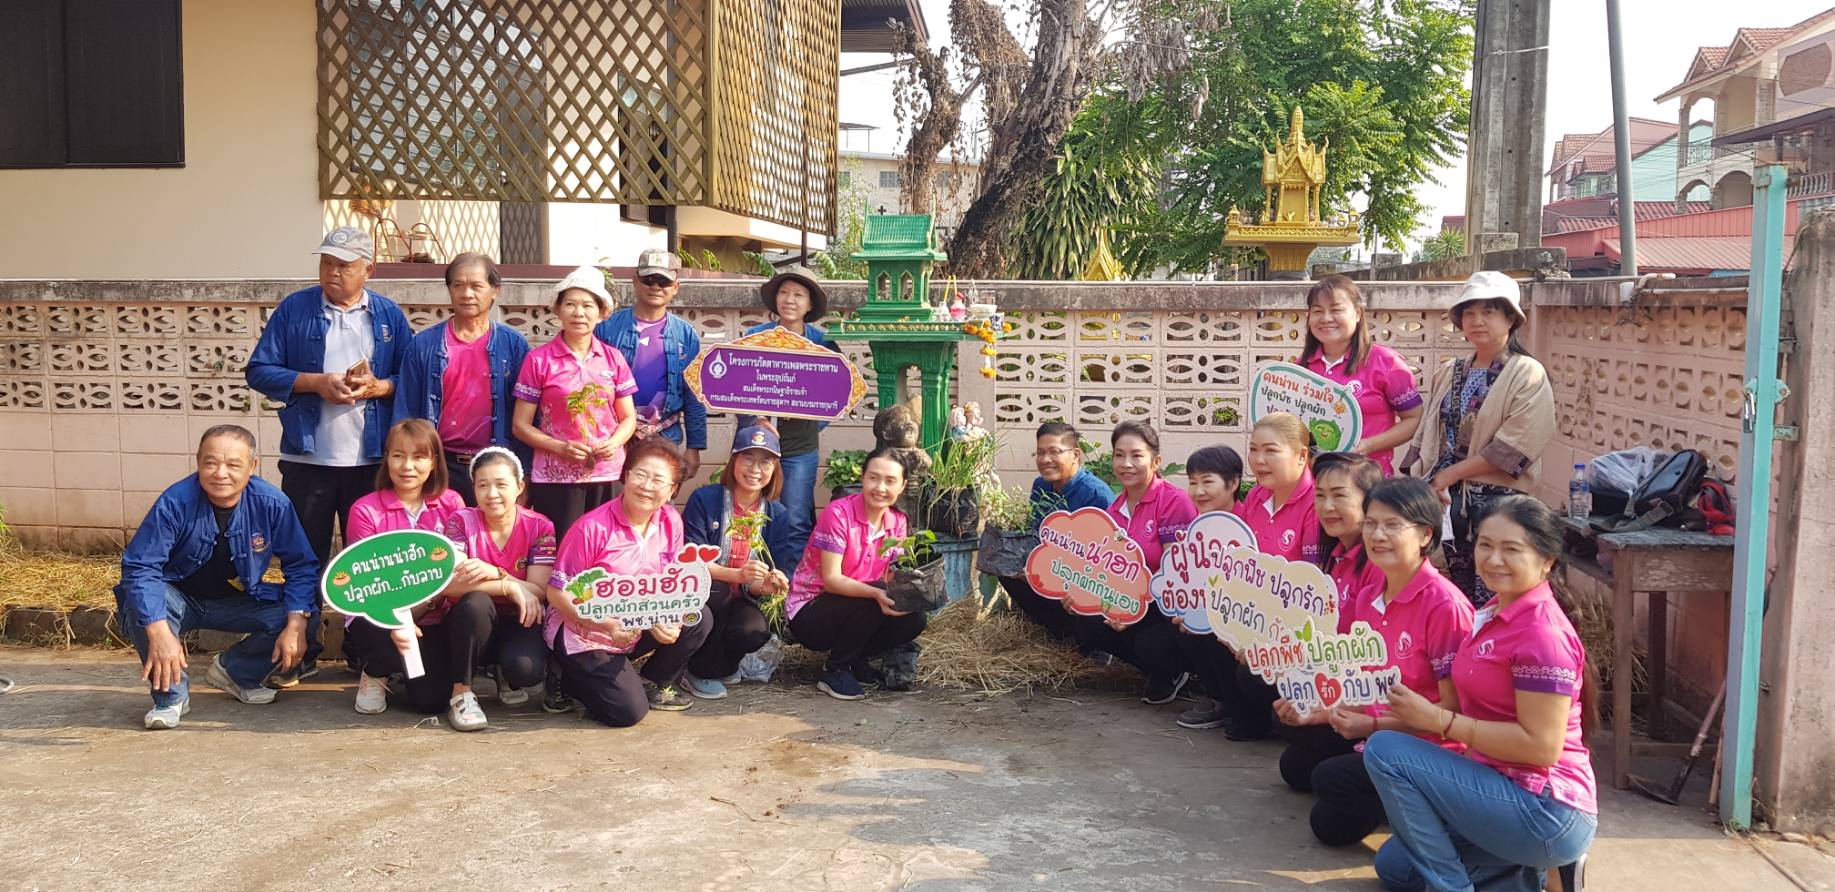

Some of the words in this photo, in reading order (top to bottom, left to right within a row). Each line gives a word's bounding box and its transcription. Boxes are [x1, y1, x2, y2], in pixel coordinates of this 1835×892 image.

[1261, 386, 1292, 405] ปลูกพืช
[1295, 397, 1326, 417] ปลูกผัก
[1263, 372, 1299, 392] คนน่าน
[1303, 382, 1334, 404] ร่วมใจ
[352, 543, 426, 575] คนน่านน่าฮัก
[595, 567, 699, 598] ฮอมฮัก
[1051, 559, 1139, 614] ปลูกผักกินเอง
[1211, 548, 1266, 588] ปลูกพืช
[1270, 573, 1324, 616] ปลูกรัก
[578, 594, 701, 620] ปลูกผักสวนครัว
[622, 612, 680, 627] พช.น่าน
[1211, 588, 1265, 634] ปลูกผัก
[1247, 636, 1303, 678] ปลูกพืช
[1308, 627, 1384, 673] ปลูกผัก
[1280, 676, 1315, 711] ปลูก
[1320, 681, 1336, 698] รัก
[1342, 669, 1371, 699] กับ
